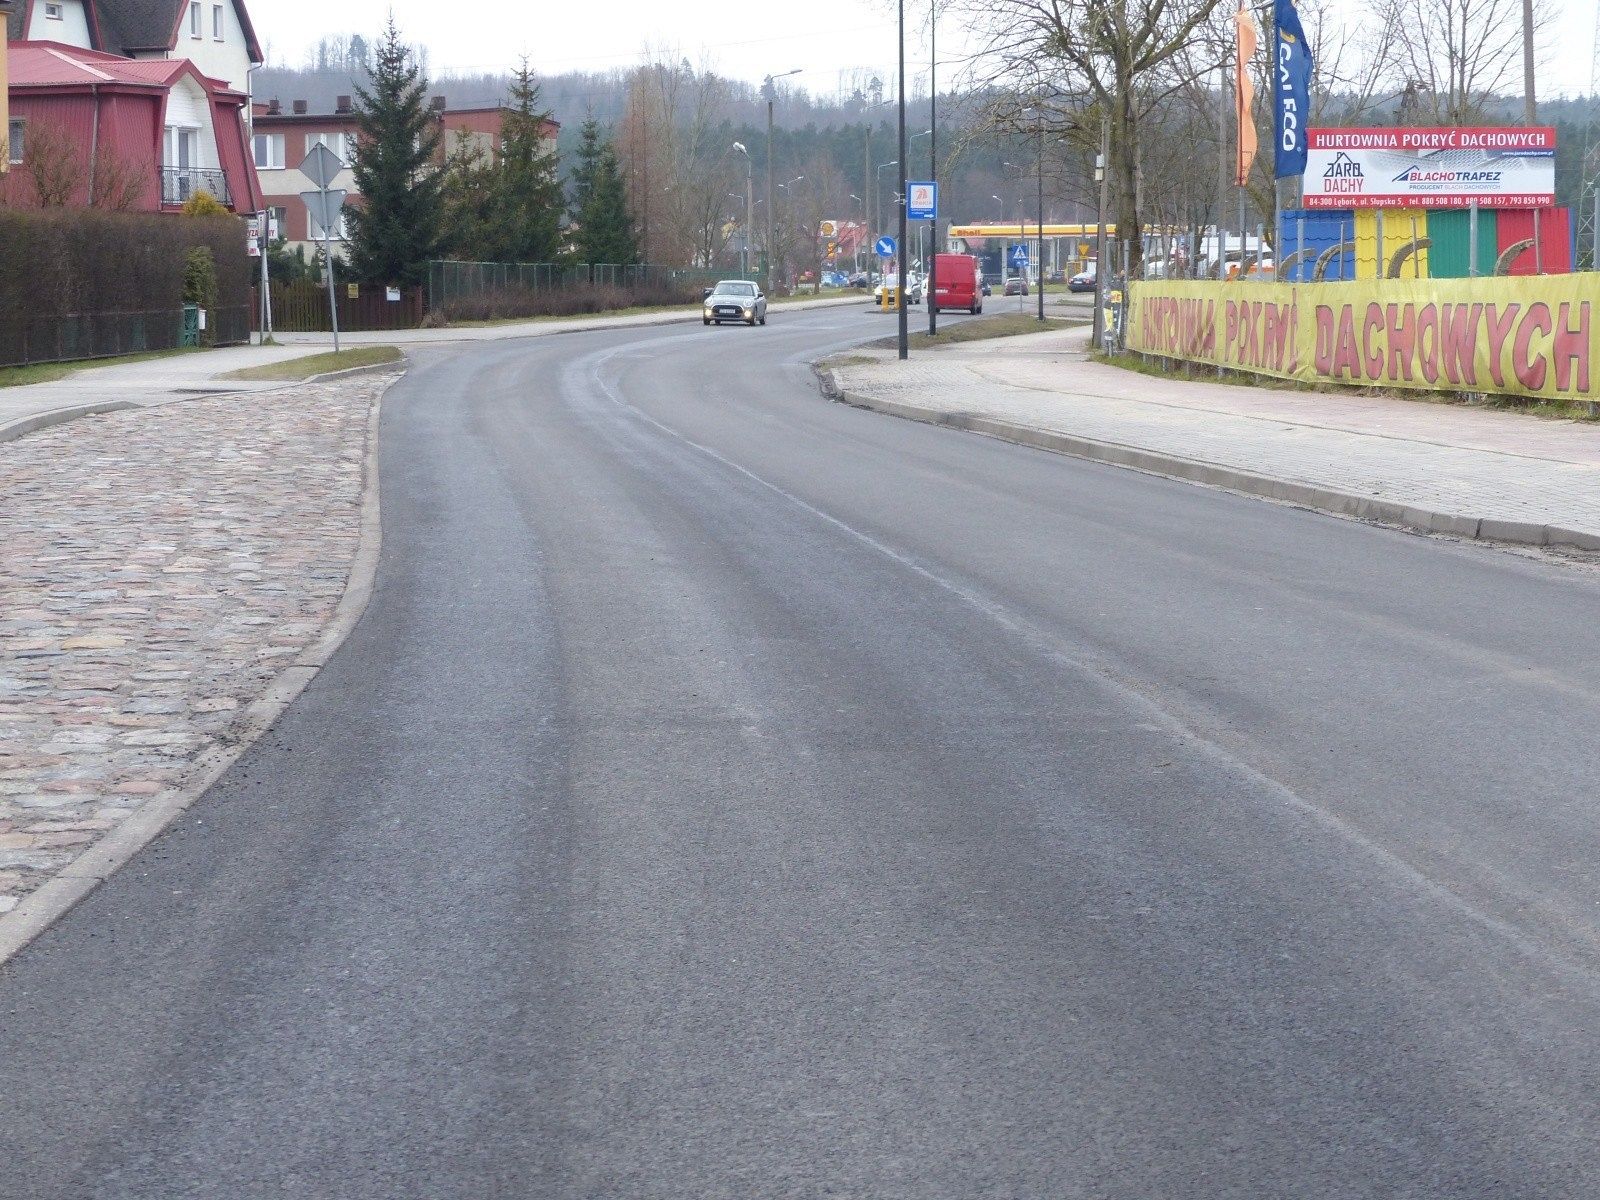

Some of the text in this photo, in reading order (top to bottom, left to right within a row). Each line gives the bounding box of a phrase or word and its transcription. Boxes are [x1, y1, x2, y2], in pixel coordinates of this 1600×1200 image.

[1316, 131, 1545, 147] HURTOWNIA POKRYĆ DACHOWYCH
[1410, 172, 1501, 181] BLACHOTRAPEZ
[1324, 179, 1363, 192] DACHY
[1309, 198, 1333, 206] 84-300
[1360, 198, 1369, 206] ul.
[1397, 198, 1404, 206] 5,
[1409, 197, 1419, 205] tel.
[1421, 197, 1434, 205] 880
[1435, 197, 1448, 205] 508
[1450, 197, 1464, 206] 180,
[1480, 197, 1492, 205] 508
[1494, 197, 1508, 206] 157,
[1509, 197, 1521, 205] 793
[1523, 197, 1536, 205] 850
[1537, 196, 1550, 205] 990
[1315, 300, 1590, 393] DACHOWYCH
